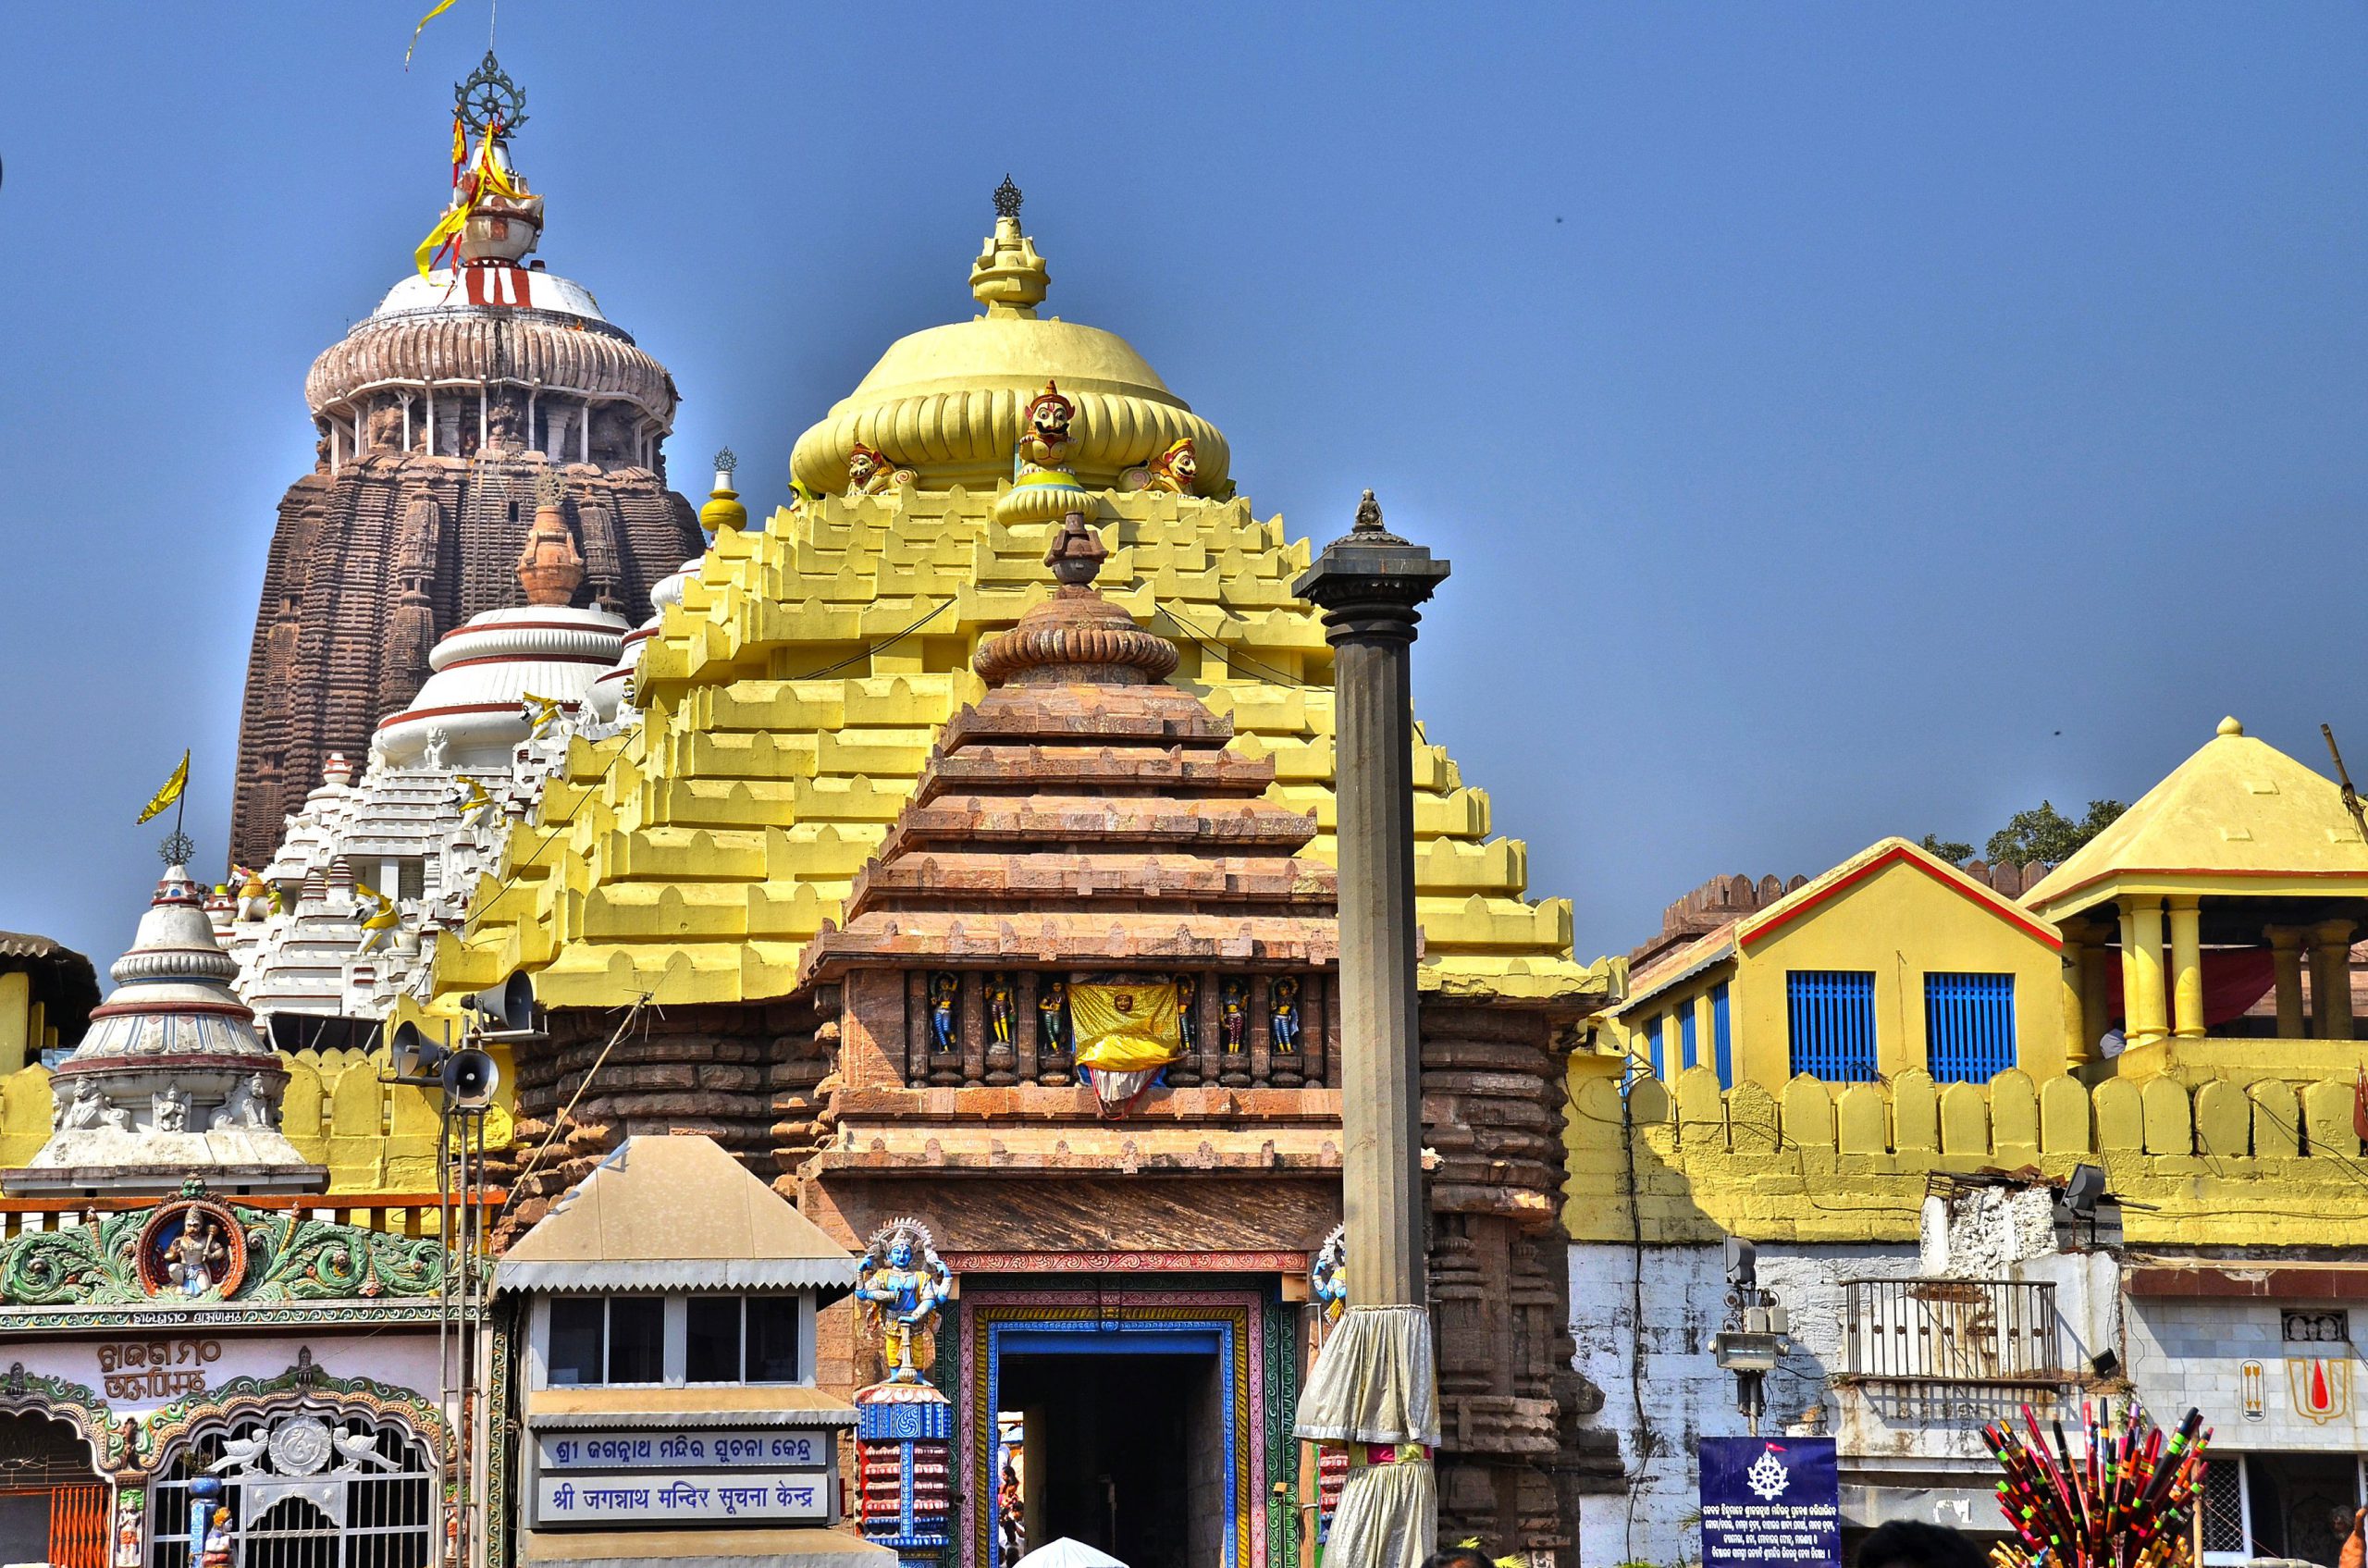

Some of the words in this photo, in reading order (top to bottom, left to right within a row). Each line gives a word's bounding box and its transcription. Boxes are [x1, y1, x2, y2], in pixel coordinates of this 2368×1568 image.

[556, 1439, 578, 1463] ଶ୍ରୀ
[587, 1439, 651, 1463] ଜଗନ୍ନାଥ
[660, 1434, 704, 1459] ମନ୍ଦିର
[714, 1438, 762, 1463] ସୂଚନା
[771, 1438, 811, 1461] କେନ୍ଦ୍ର
[552, 1482, 574, 1510] श्री
[583, 1488, 649, 1510] जगन्नाथ
[658, 1480, 709, 1509] मन्दिर
[718, 1488, 768, 1515] सूचना
[776, 1480, 814, 1508] केन्द्र
